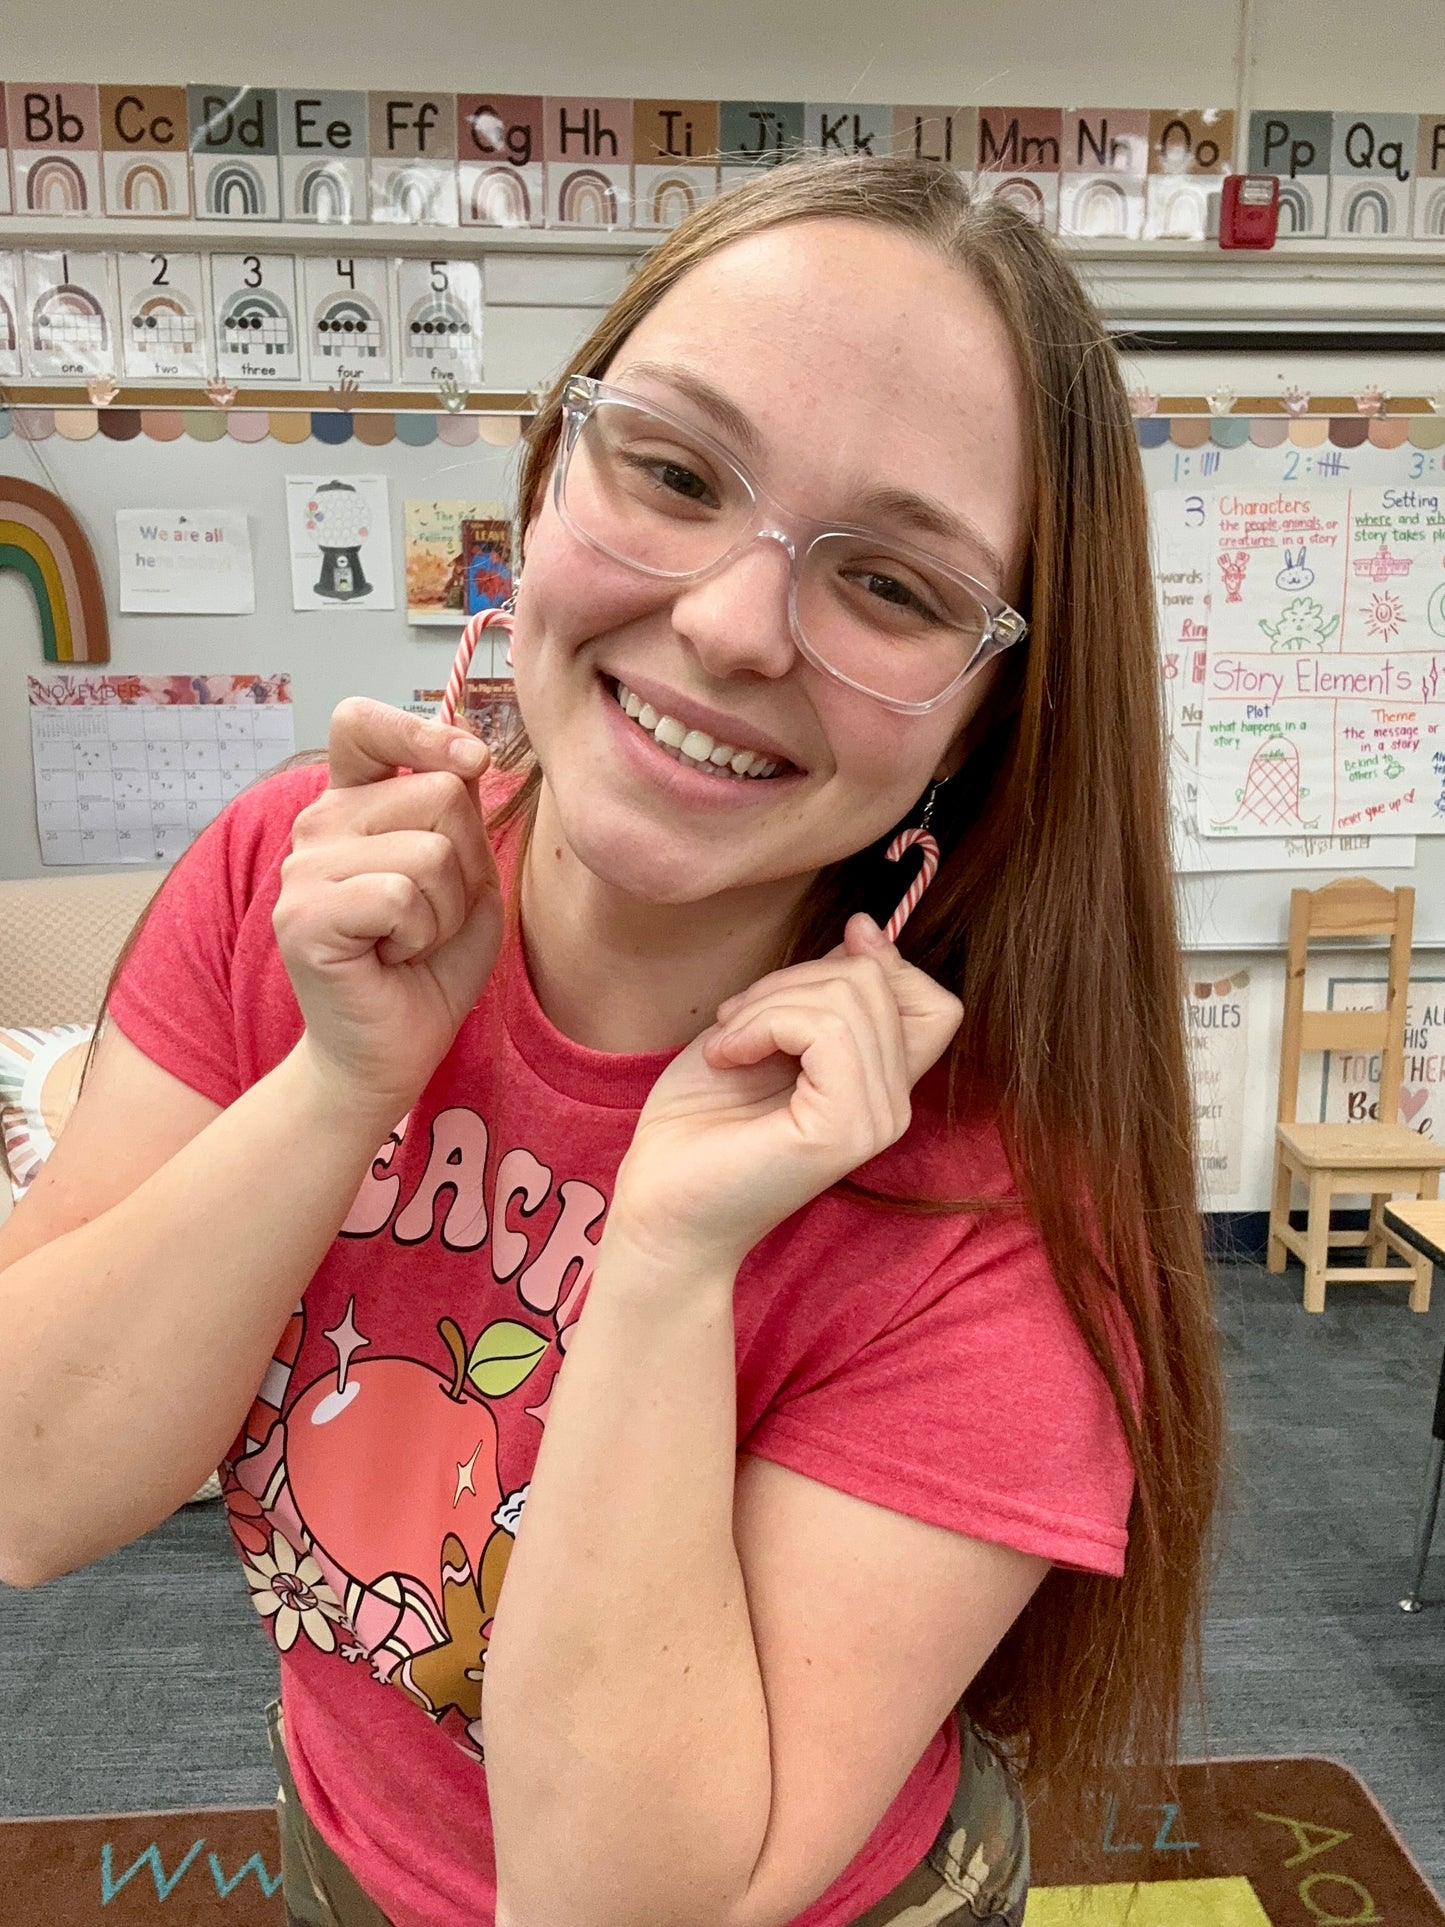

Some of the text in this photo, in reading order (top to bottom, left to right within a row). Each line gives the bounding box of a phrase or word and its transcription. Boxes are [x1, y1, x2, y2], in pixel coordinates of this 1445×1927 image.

[24, 93, 84, 144] Bb
[114, 96, 175, 144] Cc
[203, 97, 265, 148] Dd
[295, 99, 352, 148] Ee
[386, 100, 439, 151] Ff
[471, 103, 532, 166] Gg
[559, 107, 618, 157] Hh
[658, 109, 694, 157] Ii
[740, 111, 784, 165] Jj
[821, 113, 876, 157] Kk
[915, 115, 952, 163] Ll
[979, 116, 1060, 166] Mm
[1077, 118, 1134, 166] Nn
[1160, 119, 1220, 167] Oo
[1263, 120, 1316, 179] Pp
[1345, 121, 1410, 182] Qq
[62, 253, 69, 284] 1
[150, 255, 170, 286] 2
[242, 256, 263, 289] 3
[336, 259, 357, 290] 4
[429, 262, 449, 292] 5
[61, 363, 84, 374] one
[154, 361, 179, 375] two
[241, 363, 276, 376] three
[337, 366, 364, 381] four
[430, 366, 456, 381] five
[1283, 451, 1313, 481] 2:
[1408, 451, 1436, 480] 3:
[1219, 493, 1311, 516] Characters
[1382, 489, 1438, 513] Setting
[1220, 519, 1240, 532] the
[1325, 519, 1339, 530] or
[1355, 512, 1393, 526] where
[1398, 512, 1420, 525] and
[140, 526, 168, 541] We
[204, 527, 224, 543] all
[1219, 533, 1338, 547] creatures in a story
[1354, 529, 1387, 544] story
[1392, 529, 1427, 542] takes
[1162, 590, 1194, 606] have
[1213, 658, 1412, 706] Story Elements
[38, 683, 141, 699] NOVEMBER
[1246, 704, 1271, 719] Plot
[1371, 707, 1416, 724] Theme
[1208, 719, 1308, 737] what happens in a
[1343, 724, 1440, 740] the message or
[1213, 735, 1241, 750] story
[1360, 739, 1420, 753] in a story
[1358, 754, 1379, 768] kind
[1382, 753, 1394, 764] to
[1349, 769, 1378, 782] others
[1338, 811, 1362, 828] never
[1388, 799, 1402, 812] up
[1188, 1003, 1241, 1029] RULES
[1403, 1028, 1429, 1049] HIS
[1339, 1055, 1445, 1084] TOGHE
[338, 1106, 606, 1331] EACH
[102, 1838, 283, 1905] Ww
